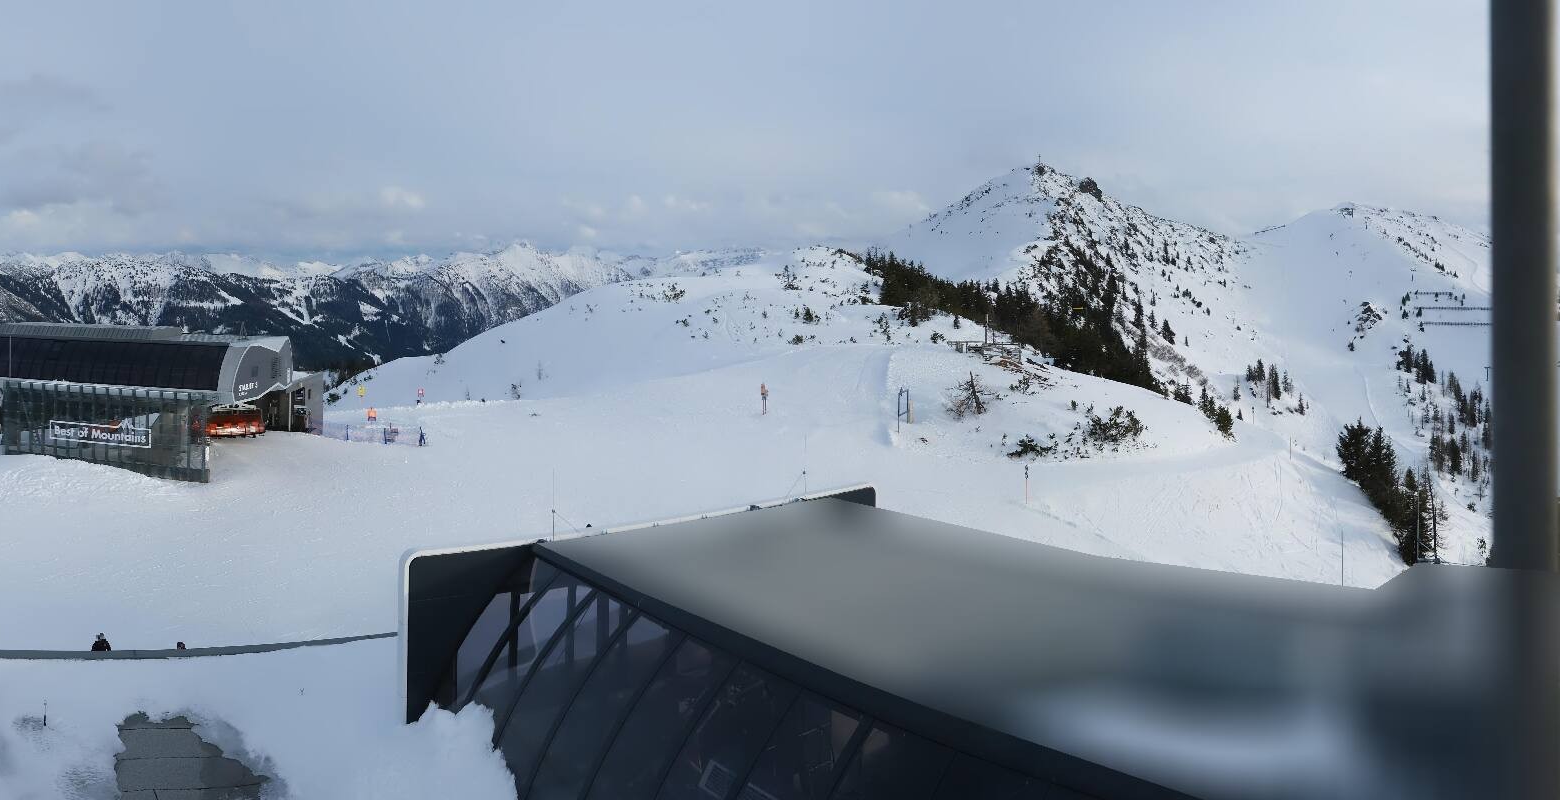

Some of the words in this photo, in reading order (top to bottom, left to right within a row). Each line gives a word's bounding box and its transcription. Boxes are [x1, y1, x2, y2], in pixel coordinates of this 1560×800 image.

[54, 425, 74, 436] Best
[77, 426, 88, 438] of
[91, 428, 147, 443] Mountains
